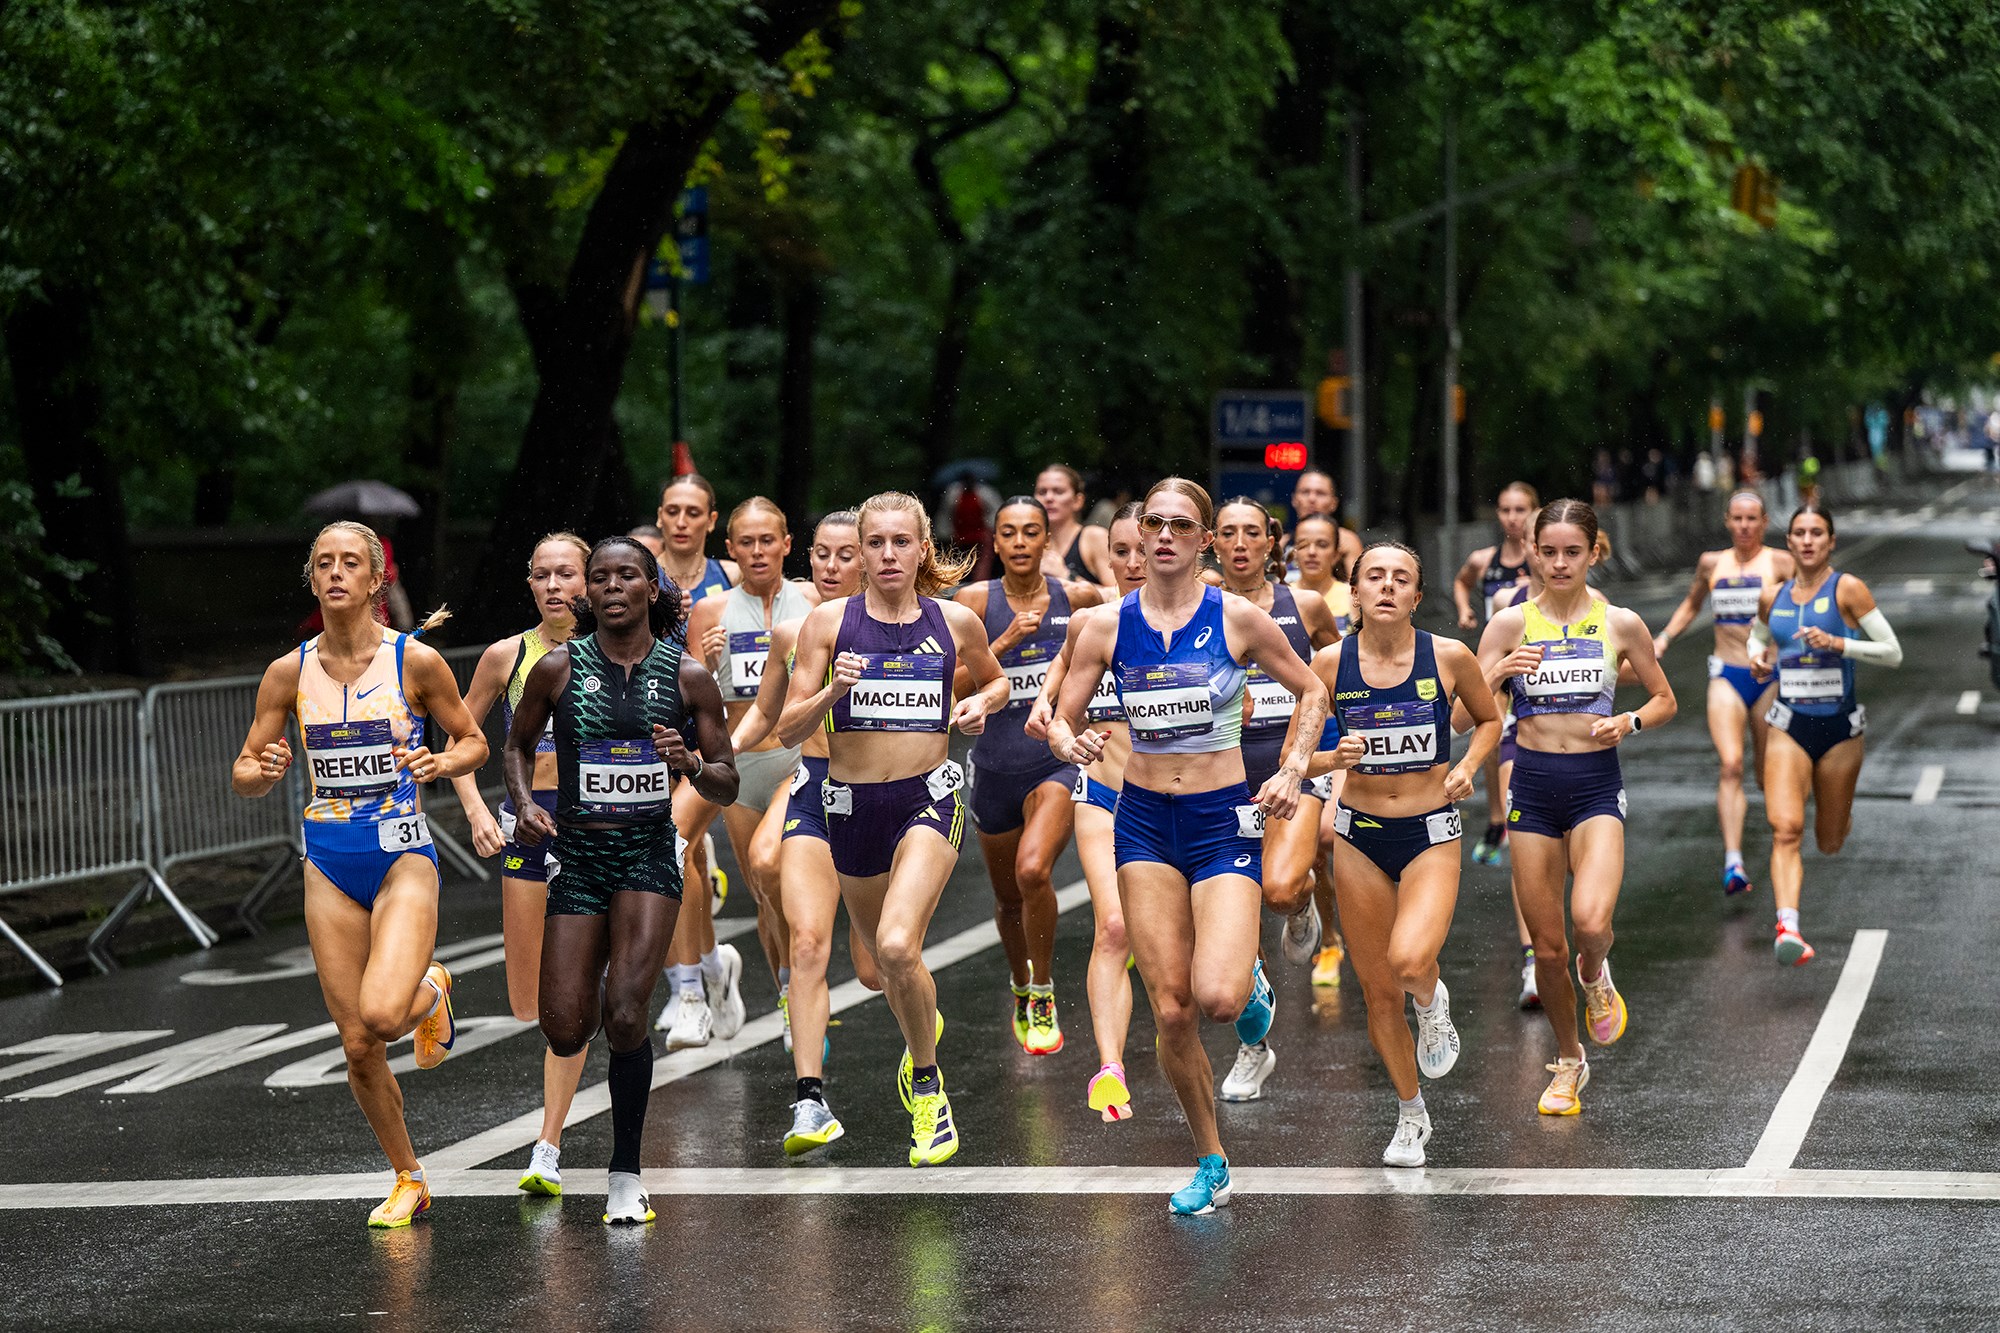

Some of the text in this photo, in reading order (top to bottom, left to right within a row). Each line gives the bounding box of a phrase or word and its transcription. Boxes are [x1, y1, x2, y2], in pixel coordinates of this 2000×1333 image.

[1051, 616, 1070, 625] HOK
[1008, 672, 1047, 690] RAC
[1526, 669, 1603, 686] CALVERT
[853, 691, 941, 708] MACLEAN
[1336, 689, 1371, 700] BROOKS
[1126, 700, 1211, 718] MCARTHUR
[312, 753, 393, 778] REEKIE
[586, 772, 664, 794] EJORE
[398, 820, 422, 844] 31
[1445, 814, 1461, 837] 32
